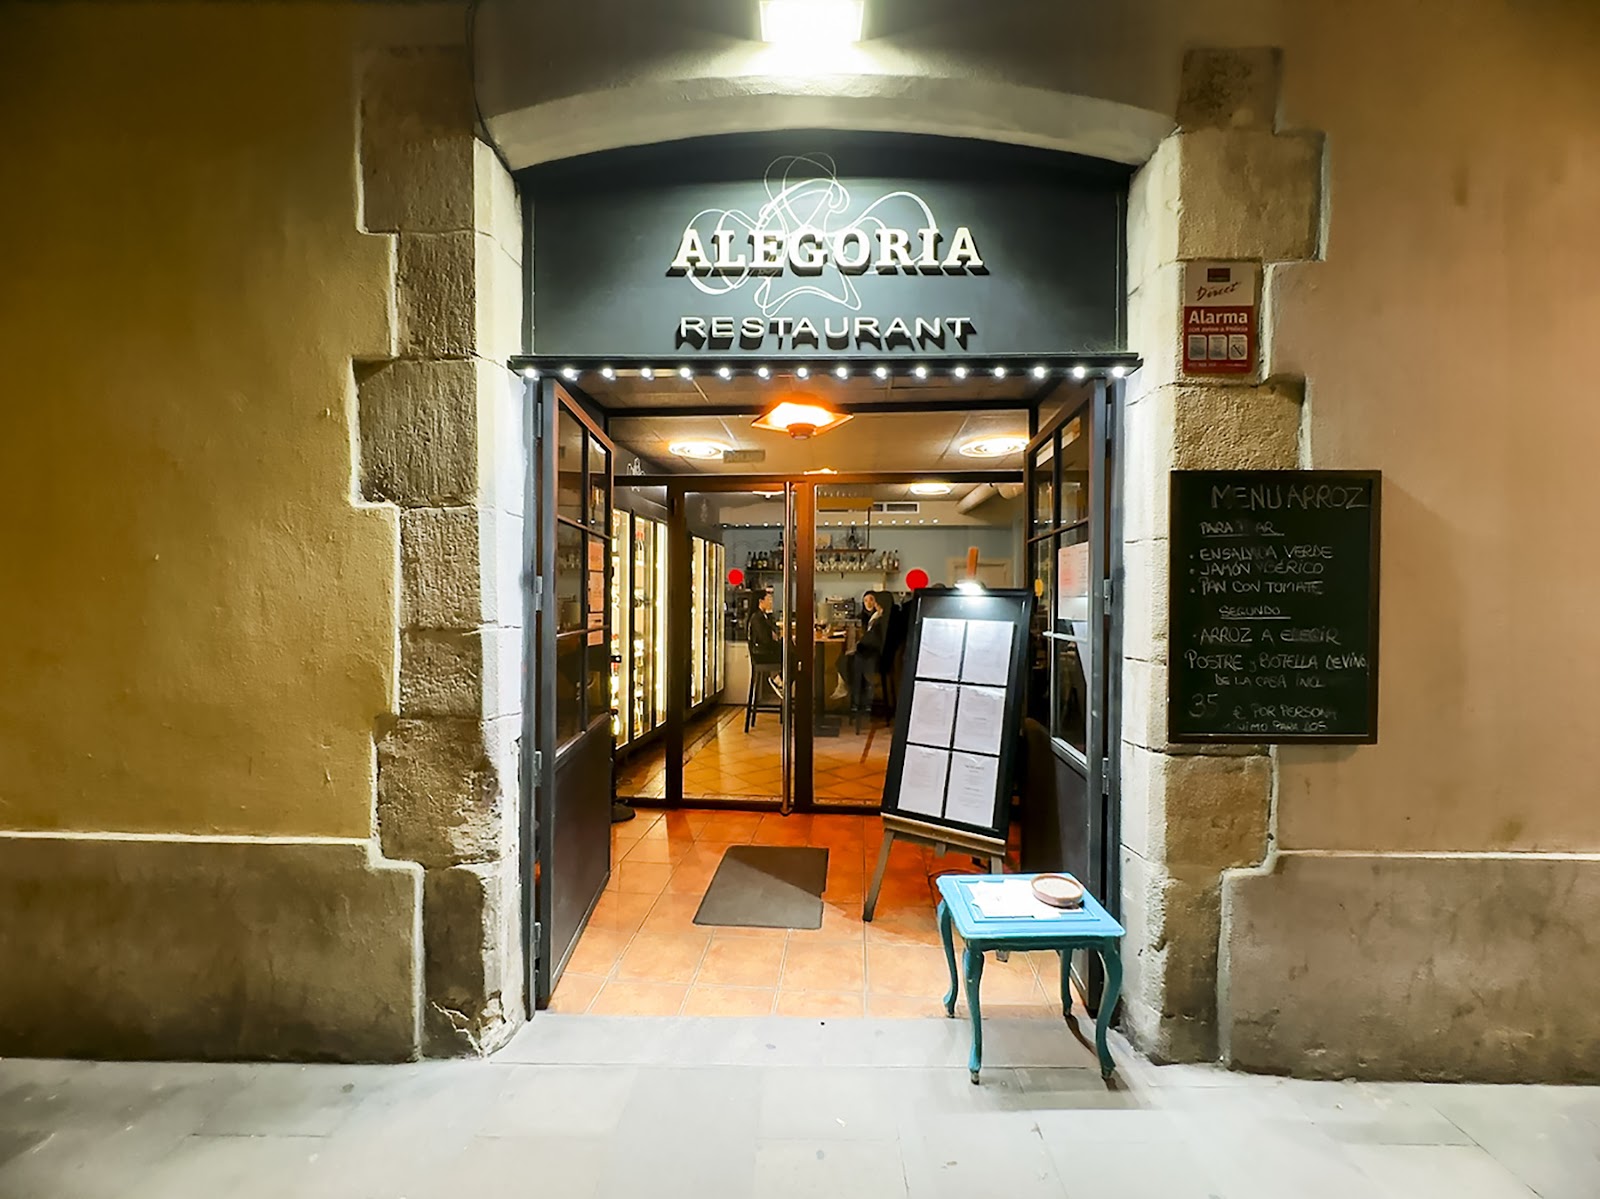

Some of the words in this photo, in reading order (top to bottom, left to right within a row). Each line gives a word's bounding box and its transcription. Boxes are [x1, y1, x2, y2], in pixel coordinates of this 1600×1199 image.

[671, 227, 984, 268] ALEGORIA
[1188, 309, 1248, 324] Alarma
[680, 317, 971, 338] RESTAURANT
[1287, 484, 1369, 510] ARROZ
[1200, 520, 1233, 535] PARA
[1283, 544, 1334, 560] VERDE
[1199, 576, 1227, 596] PAN
[1232, 579, 1261, 594] CON
[1265, 580, 1324, 595] TOMATE
[1218, 605, 1281, 617] SEGUNDO
[1200, 627, 1253, 646] ARROZ
[1261, 629, 1275, 646] A
[1184, 649, 1244, 672] POSTRE
[1258, 652, 1318, 671] BOTELLA
[1234, 674, 1251, 686] LA
[1255, 674, 1287, 688] CASA
